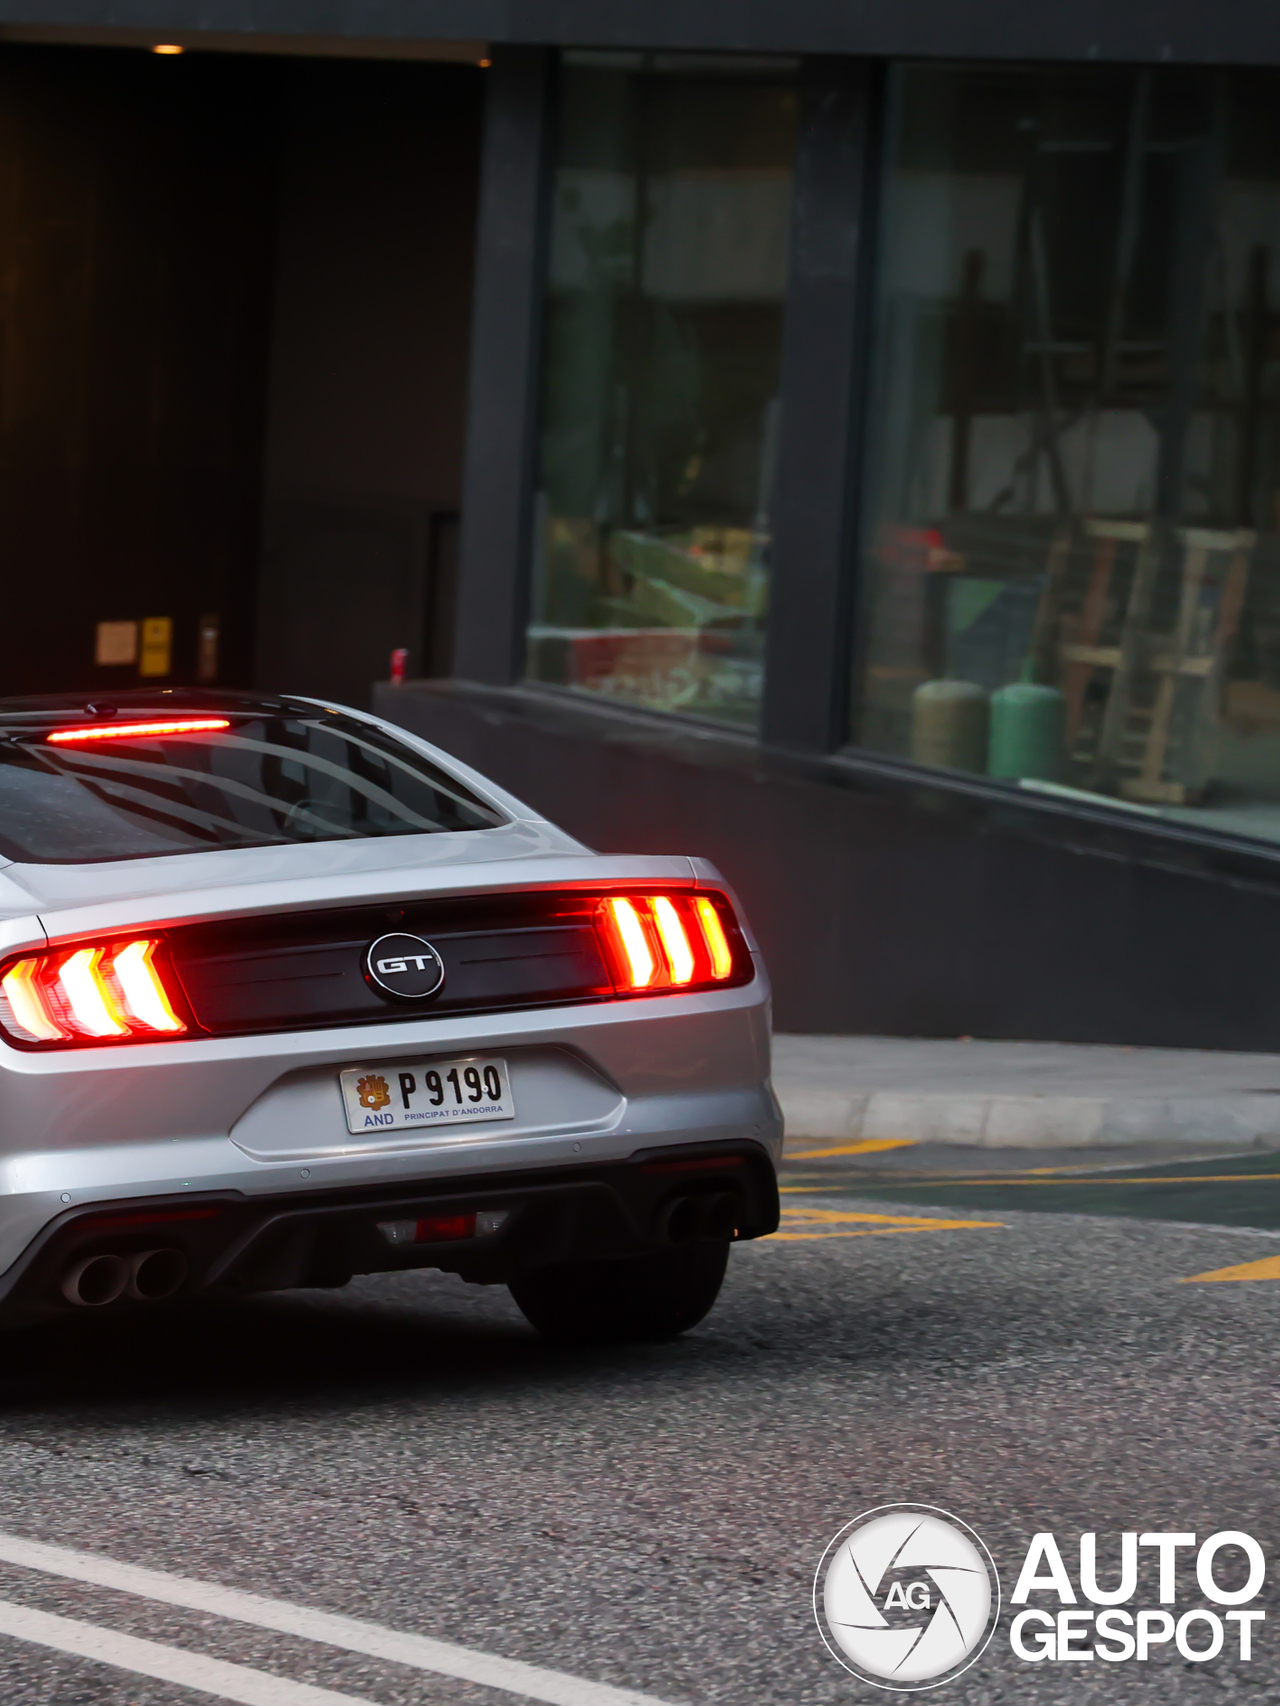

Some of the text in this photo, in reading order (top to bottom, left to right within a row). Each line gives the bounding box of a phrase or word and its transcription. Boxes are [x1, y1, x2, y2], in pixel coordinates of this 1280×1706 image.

[376, 954, 433, 974] GT
[398, 1064, 502, 1109] P 9190
[364, 1112, 394, 1127] AND
[404, 1105, 503, 1121] PRINCIPAT D'ANDORRA
